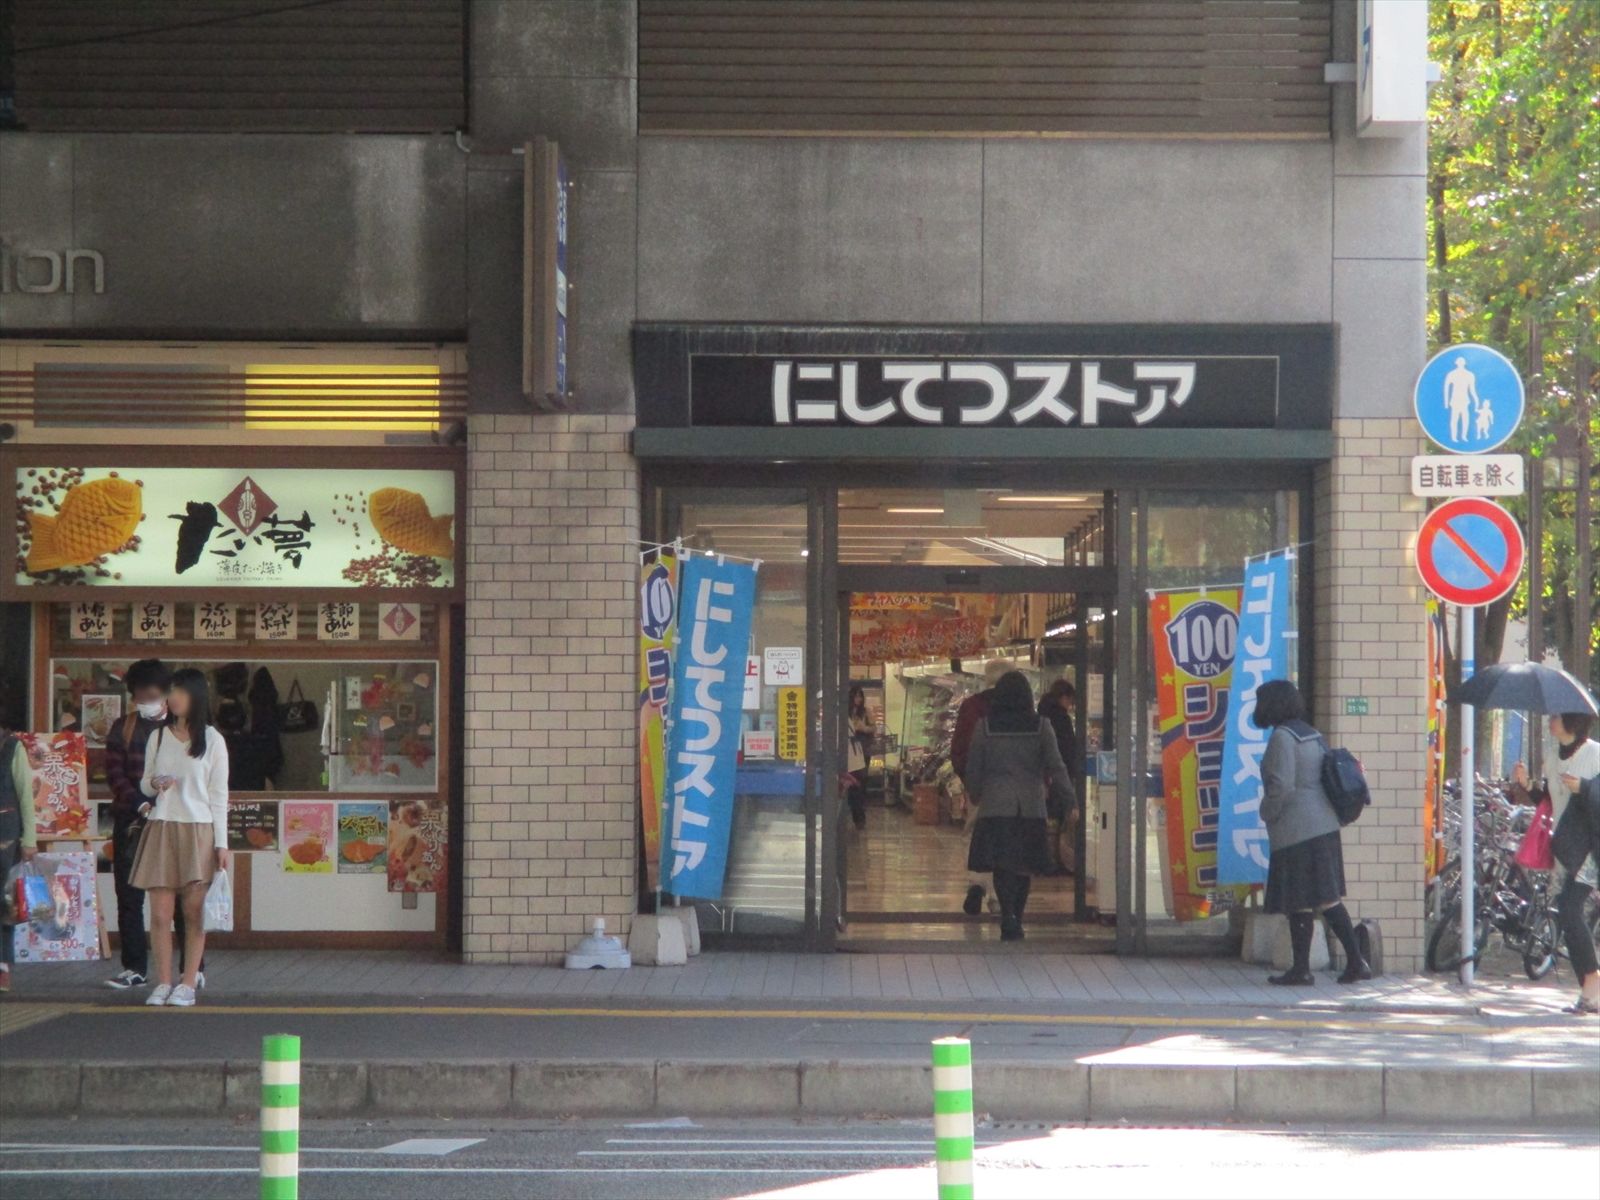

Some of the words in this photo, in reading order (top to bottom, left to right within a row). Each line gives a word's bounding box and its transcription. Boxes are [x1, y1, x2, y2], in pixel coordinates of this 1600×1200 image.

[772, 361, 1196, 425] にしてつストア
[1420, 464, 1515, 488] 自転車を除く
[141, 617, 169, 632] あん
[325, 617, 353, 633] あん
[1169, 612, 1237, 664] 100
[1193, 661, 1221, 676] YEN
[671, 578, 735, 879] にしてつストア
